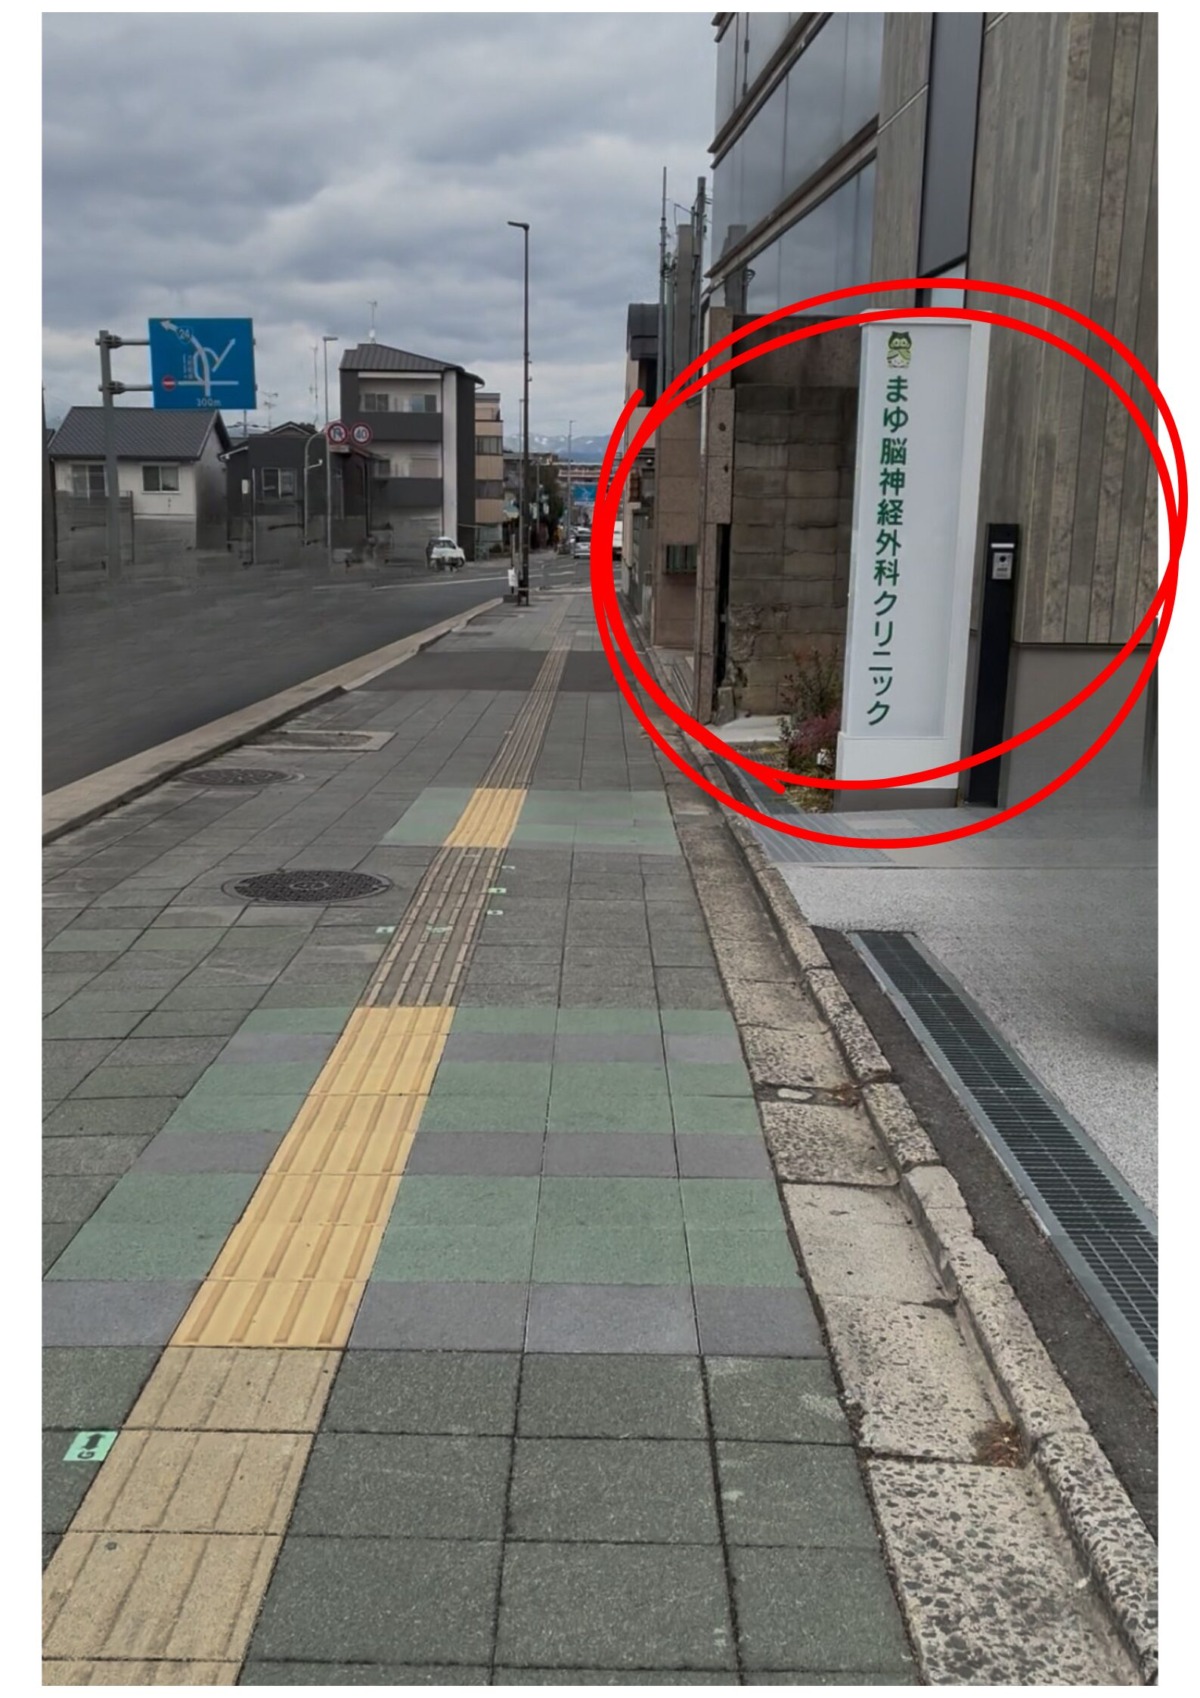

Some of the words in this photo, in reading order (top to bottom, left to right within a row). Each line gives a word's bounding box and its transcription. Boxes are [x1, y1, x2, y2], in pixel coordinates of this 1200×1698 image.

[355, 428, 367, 440] 40
[866, 375, 908, 726] まゆ脳神経外科クリニック
